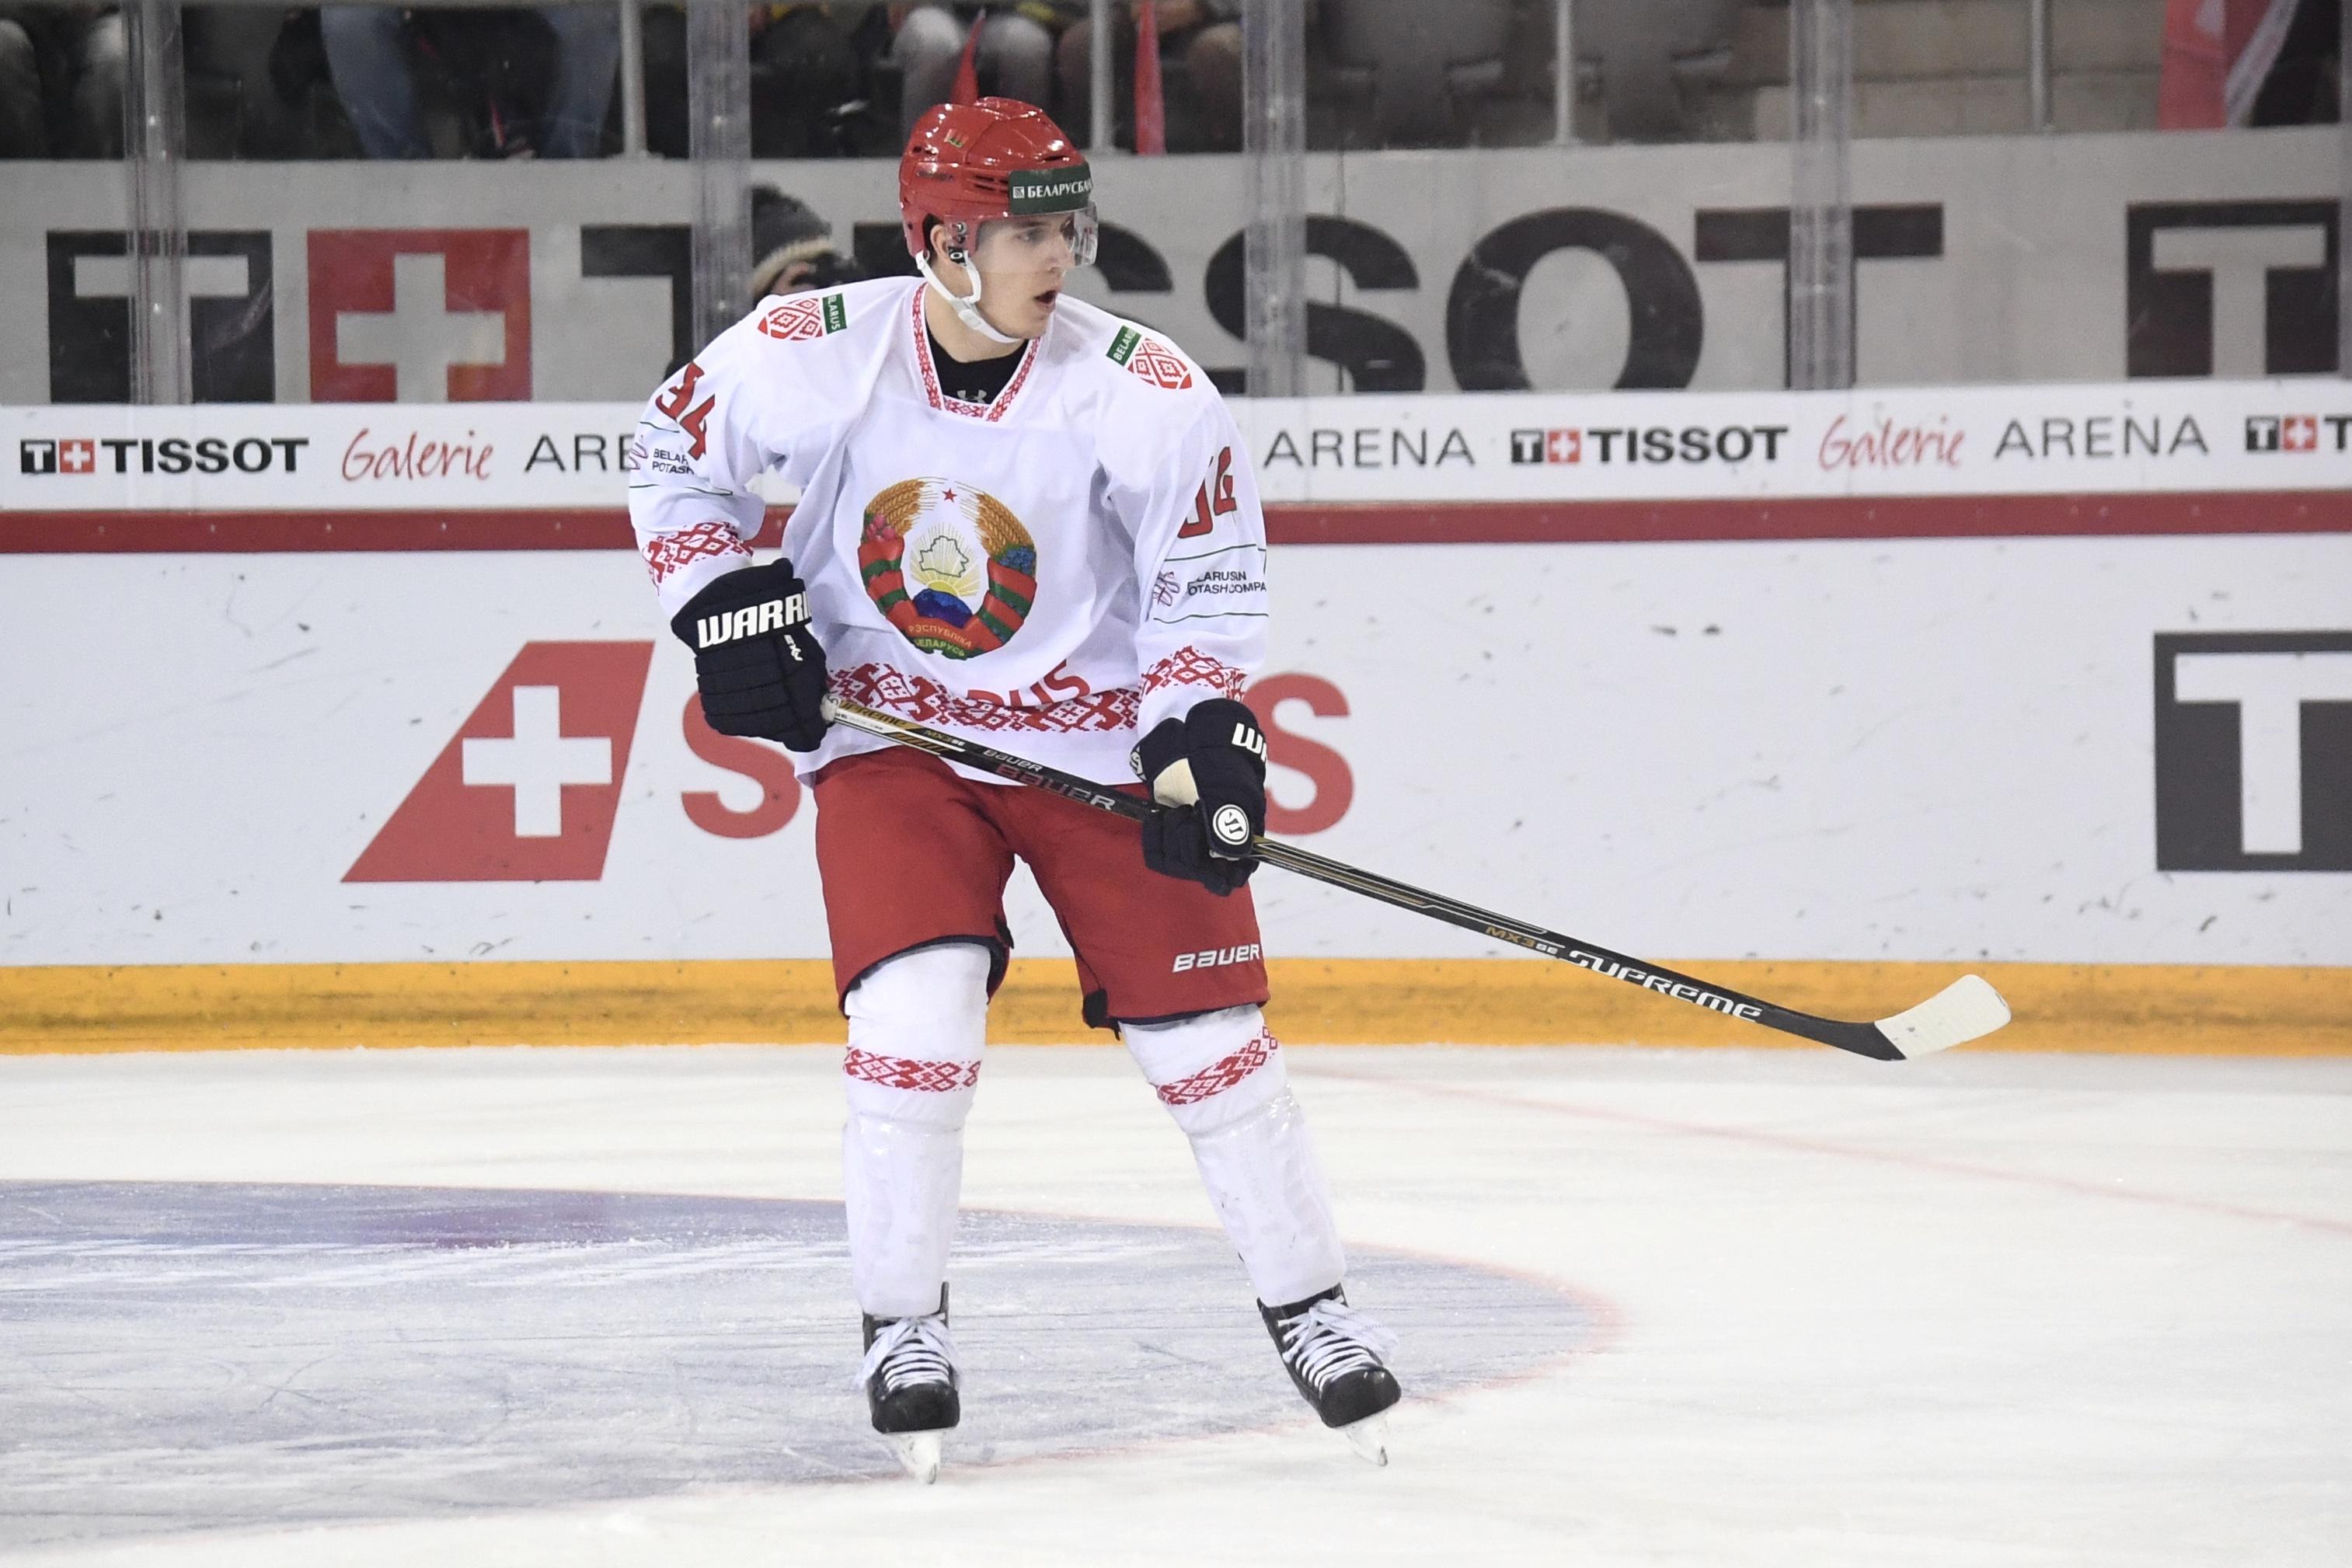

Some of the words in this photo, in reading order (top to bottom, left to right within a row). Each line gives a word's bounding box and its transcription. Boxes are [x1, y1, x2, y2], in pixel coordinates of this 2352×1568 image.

[1027, 179, 1092, 199] БЕЛАРУСБА
[101, 437, 310, 475] TISSOT
[341, 427, 496, 483] Galerie
[524, 433, 636, 473] ARE
[1263, 427, 1476, 468] ARENA
[1587, 427, 1788, 463] TISSOT
[1818, 413, 1967, 471] Galerie
[1994, 414, 2210, 459] ARENA
[697, 591, 811, 649] WARRI
